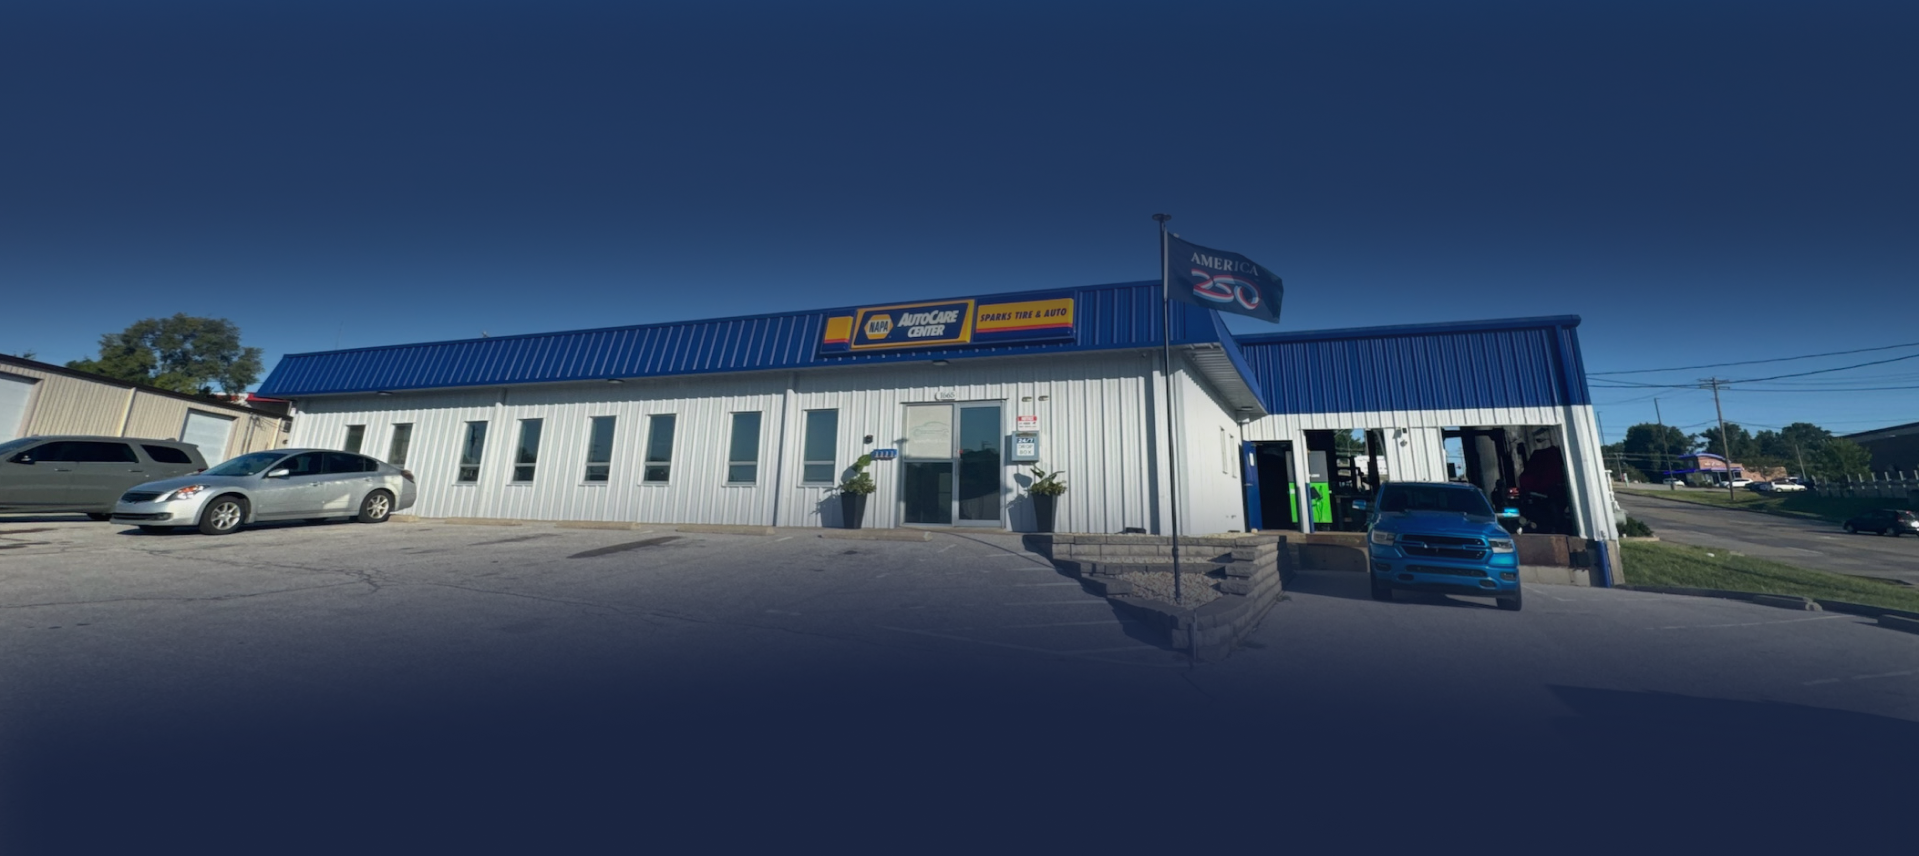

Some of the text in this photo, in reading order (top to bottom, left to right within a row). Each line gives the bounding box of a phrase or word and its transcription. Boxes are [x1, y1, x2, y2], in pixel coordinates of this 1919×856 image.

[1191, 252, 1258, 276] AMERICA
[1191, 269, 1261, 310] 250
[980, 308, 1067, 322] SPARKS TIRE & AUTO
[869, 320, 889, 333] NAPA
[907, 324, 945, 338] CENTER
